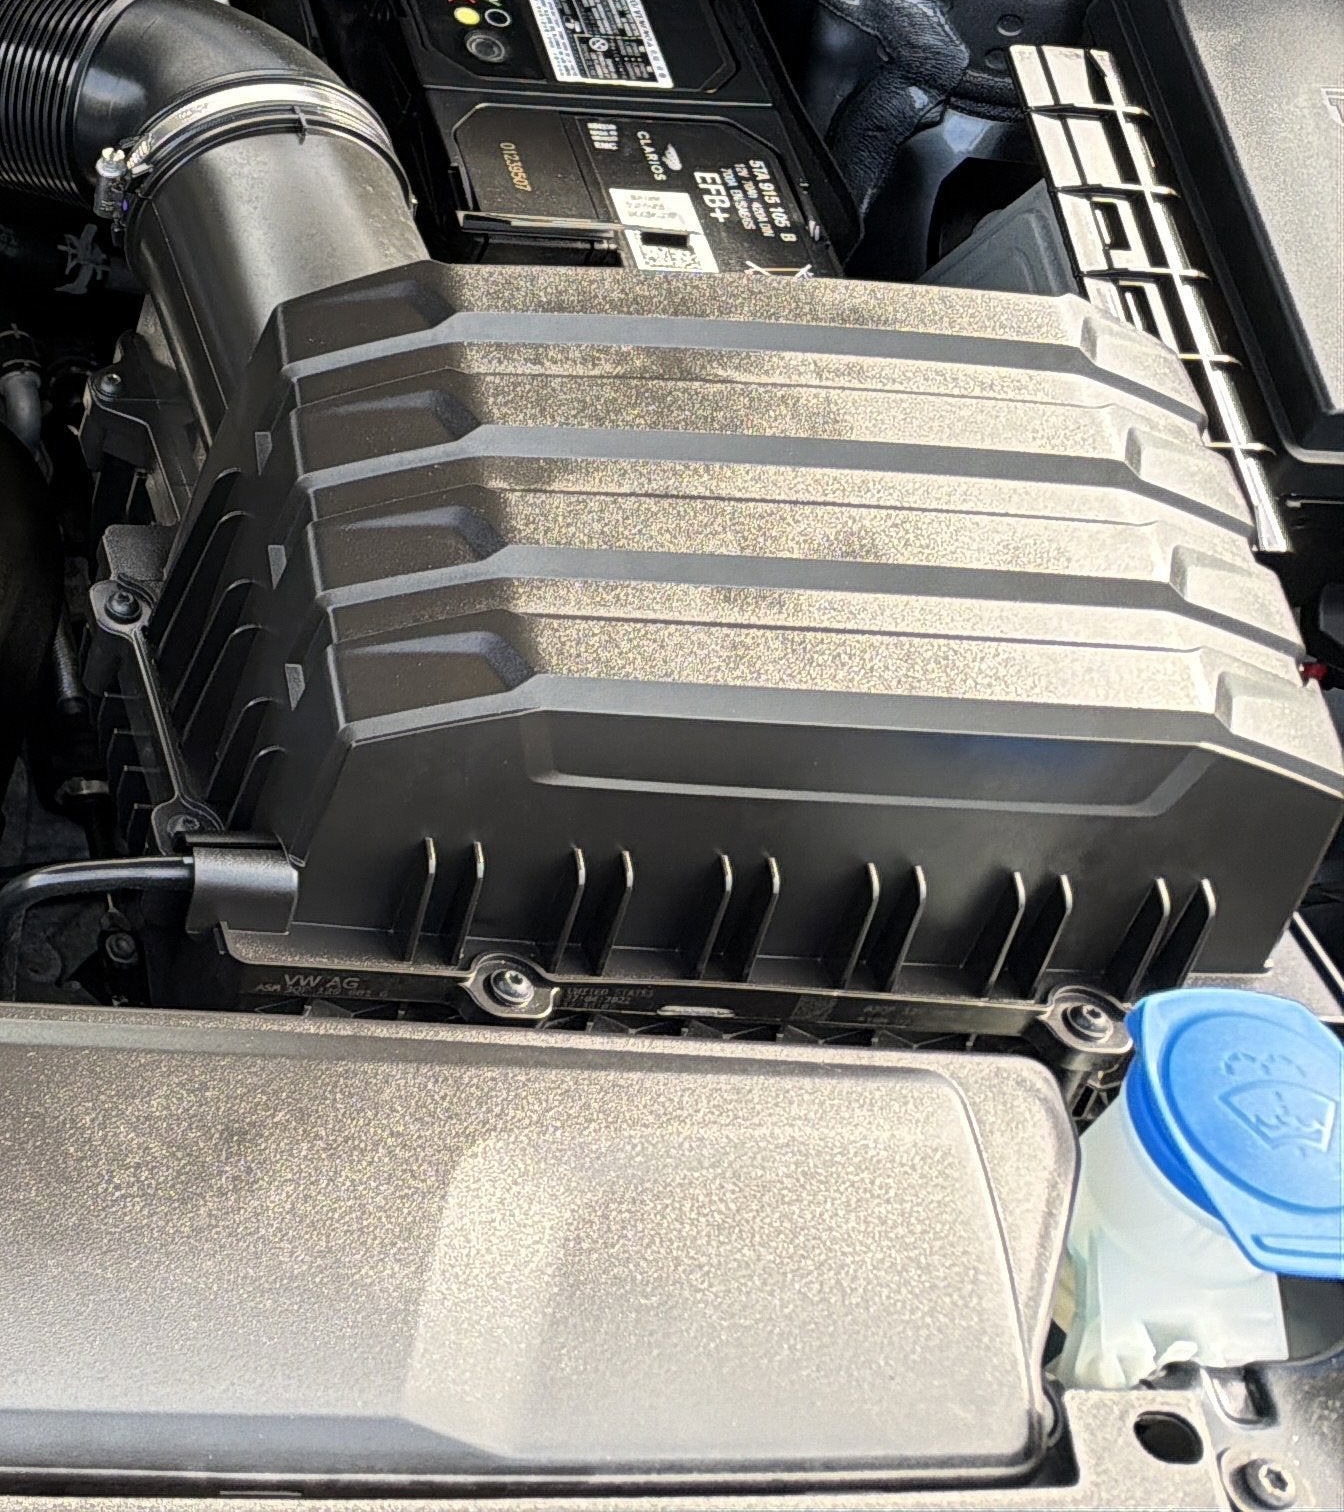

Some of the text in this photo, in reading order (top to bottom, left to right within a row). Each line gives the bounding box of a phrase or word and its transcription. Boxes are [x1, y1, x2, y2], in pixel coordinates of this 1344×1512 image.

[637, 130, 667, 181] CLARIOS
[693, 171, 731, 223] EFB+
[284, 974, 361, 989] VW AG
